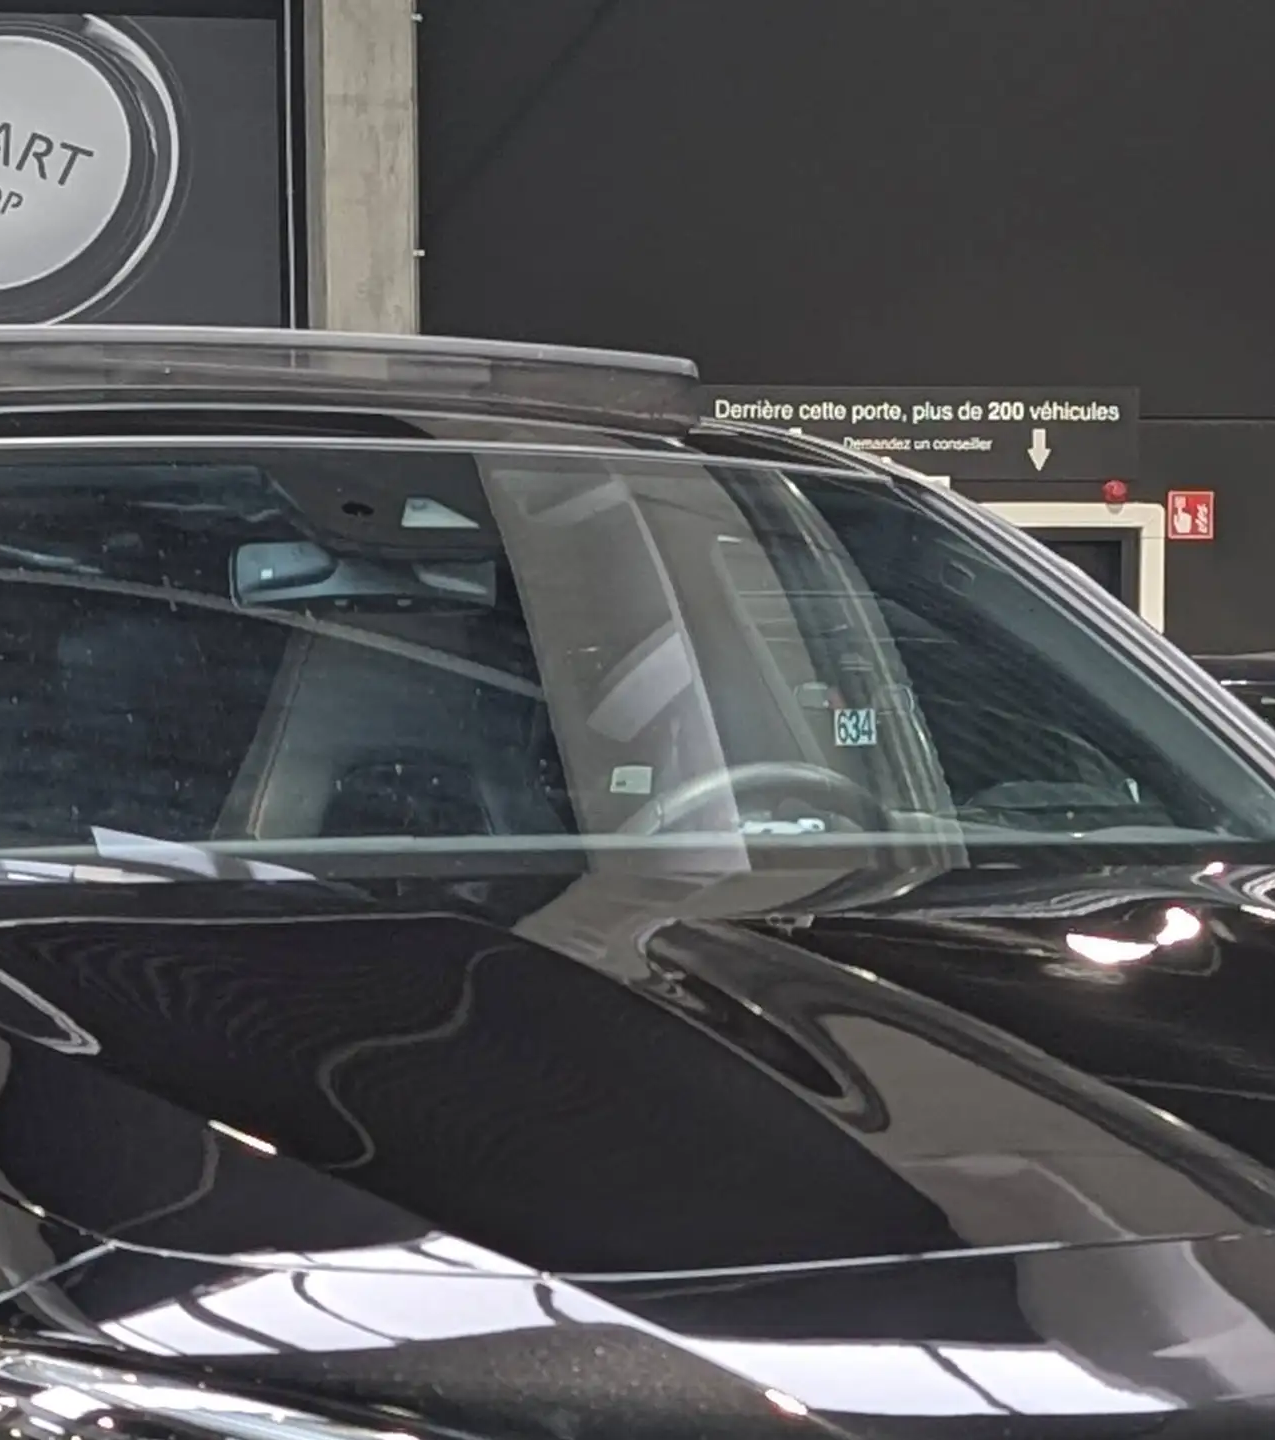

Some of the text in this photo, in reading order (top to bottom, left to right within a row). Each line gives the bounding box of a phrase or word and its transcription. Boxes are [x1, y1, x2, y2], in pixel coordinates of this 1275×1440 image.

[714, 399, 1120, 424] Derrière cette porte, plus de 200 véhicules
[843, 436, 911, 451] Demandez
[838, 709, 873, 744] 634
